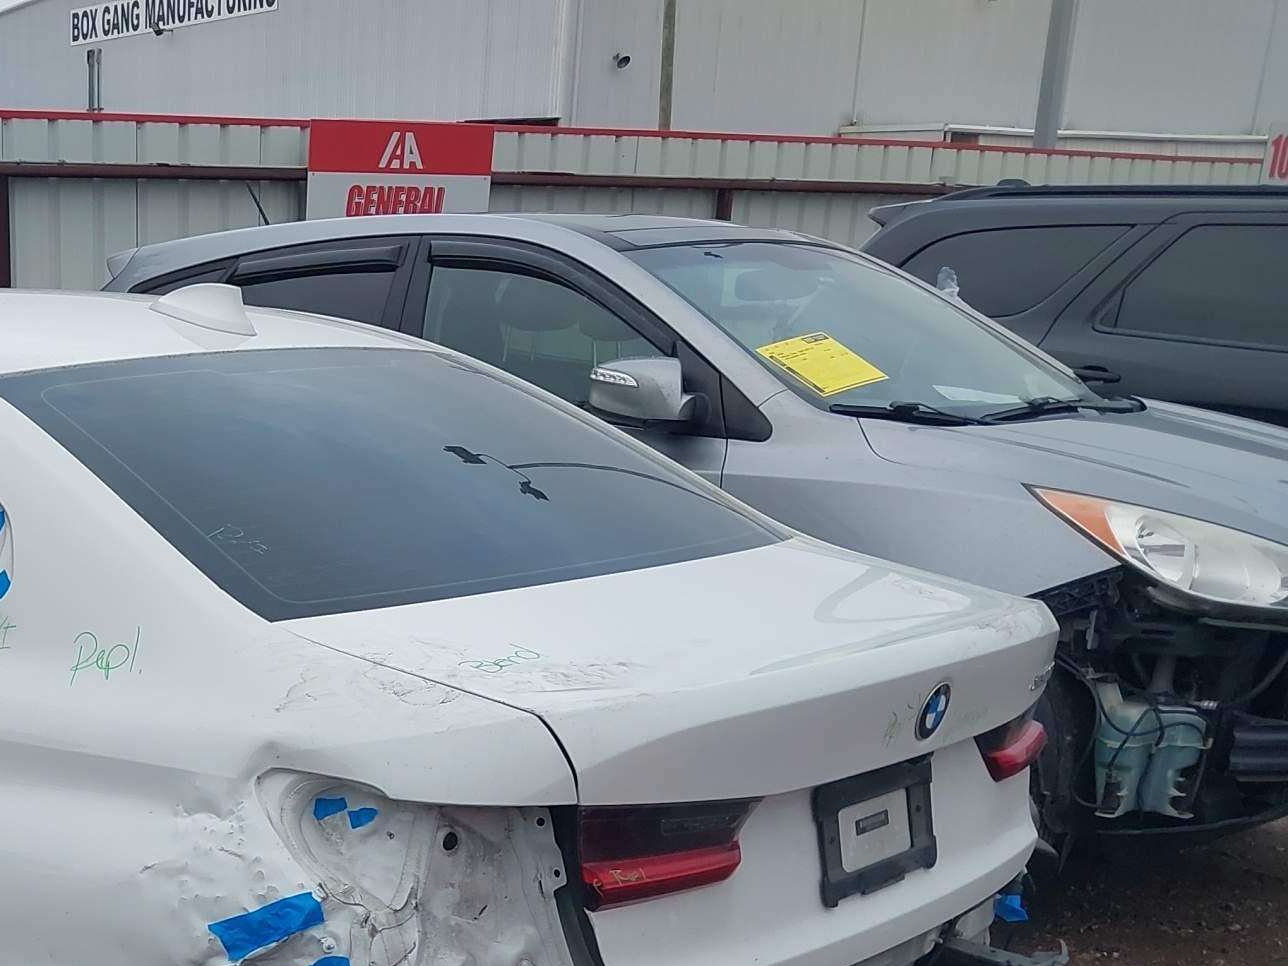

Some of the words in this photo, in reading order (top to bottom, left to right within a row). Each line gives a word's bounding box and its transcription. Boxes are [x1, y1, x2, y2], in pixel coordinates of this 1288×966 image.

[72, 8, 98, 42] BOX
[102, 1, 140, 36] GANG
[378, 131, 424, 169] IAA
[346, 184, 446, 217] GENERAL
